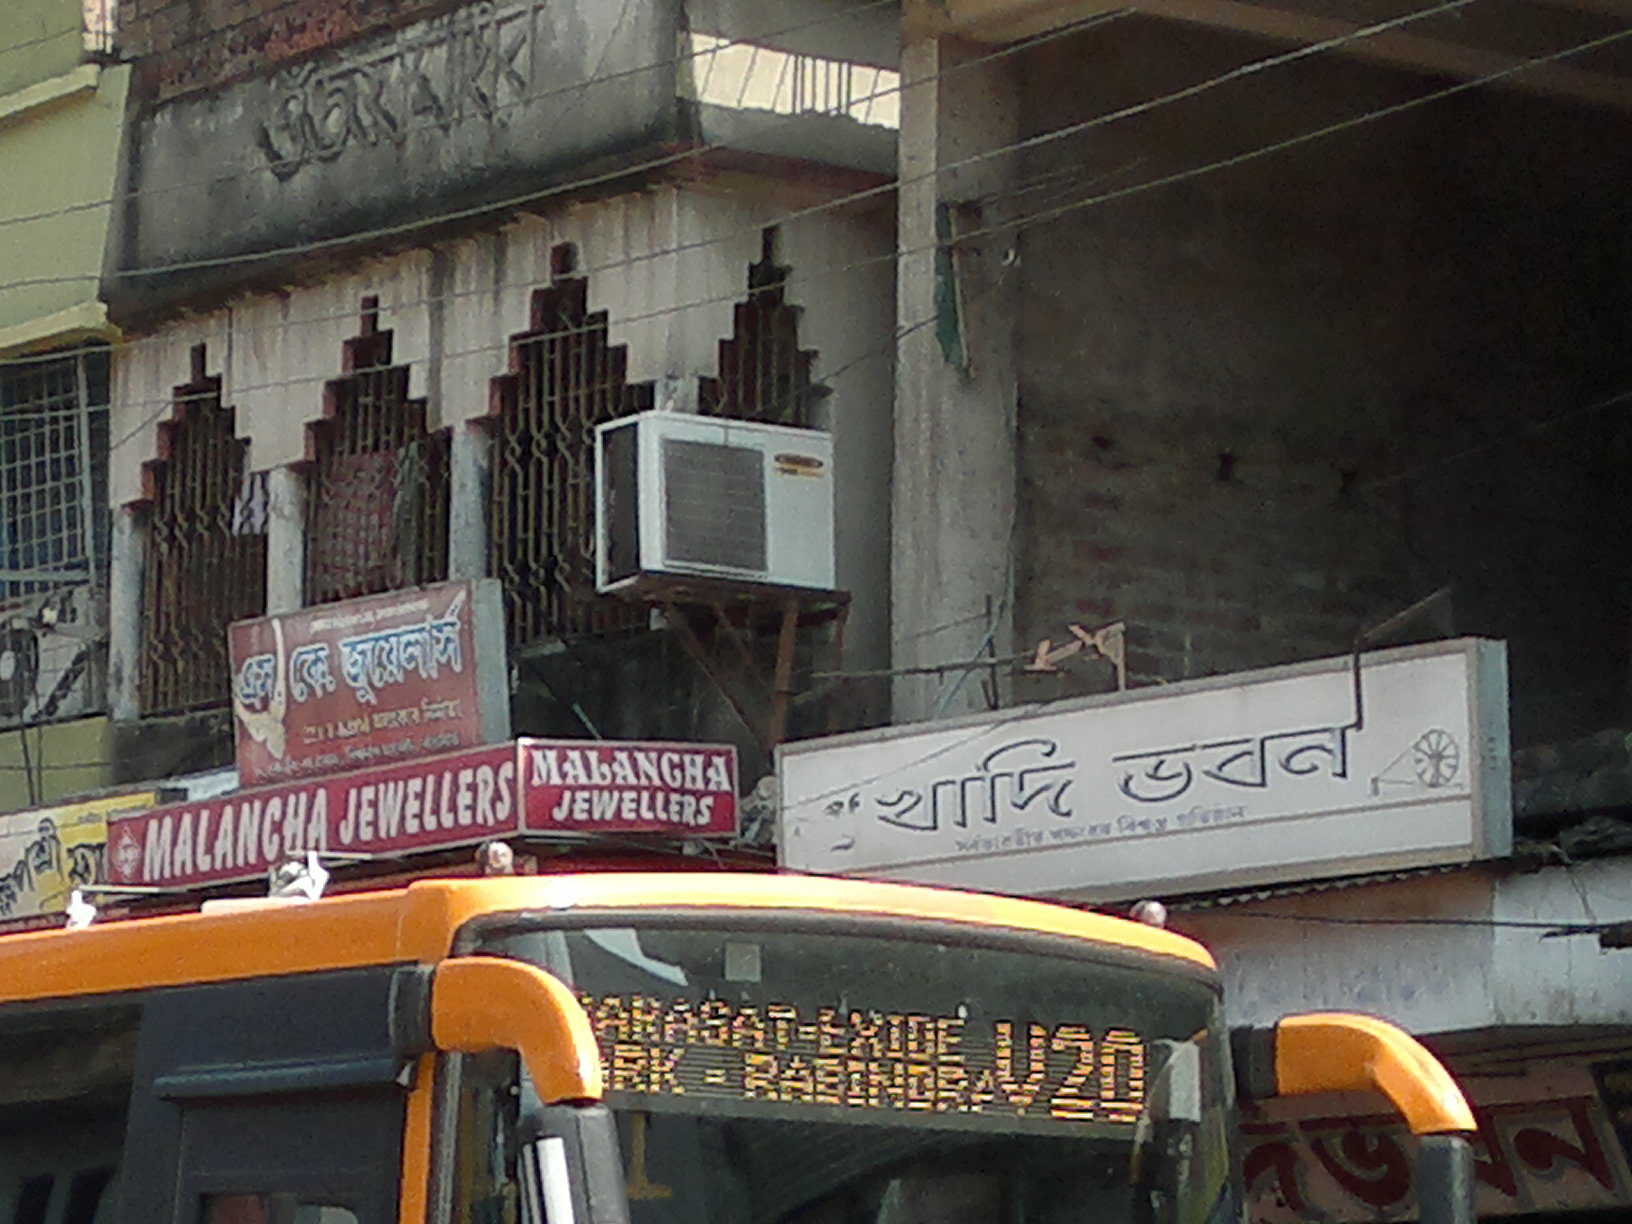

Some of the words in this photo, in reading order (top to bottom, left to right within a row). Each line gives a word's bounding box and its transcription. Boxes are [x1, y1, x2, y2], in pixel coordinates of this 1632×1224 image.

[143, 787, 331, 884] MALANCHA
[338, 761, 515, 846] JEWELLERS
[531, 747, 732, 793] MALANCHA
[552, 788, 715, 827] JEWELLERS
[876, 739, 1076, 832] খাদি
[1112, 722, 1362, 802] ভবন
[993, 1018, 1147, 1124] U20
